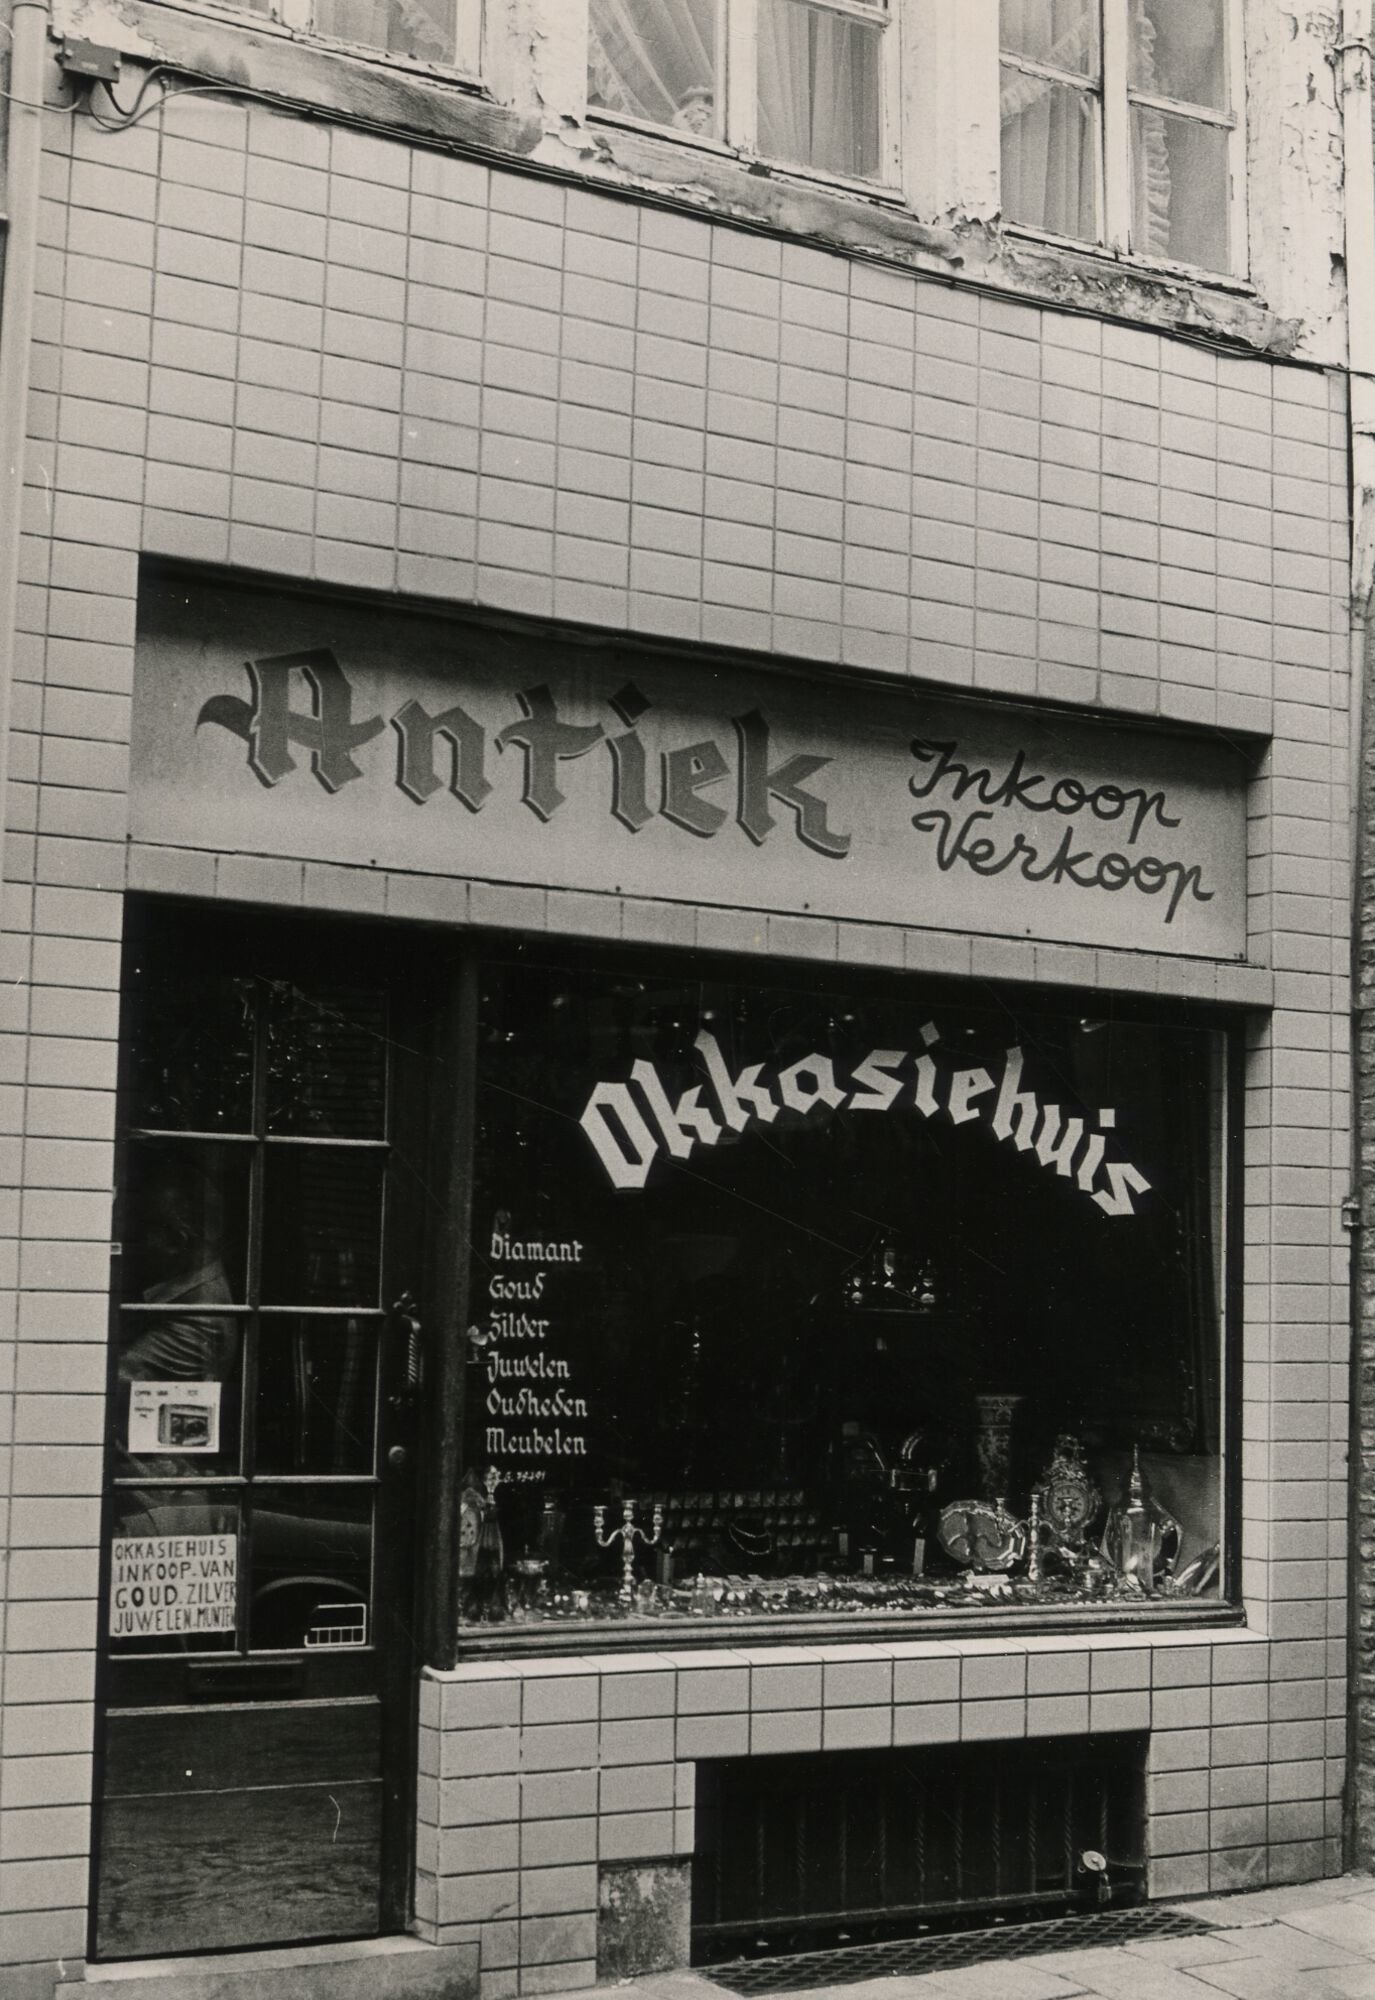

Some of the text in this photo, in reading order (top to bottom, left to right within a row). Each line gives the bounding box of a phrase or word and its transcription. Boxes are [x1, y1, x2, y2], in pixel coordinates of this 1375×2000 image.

[195, 647, 852, 860] Antiek
[908, 739, 1181, 844] Inkoop
[911, 810, 1215, 924] Verkoop
[579, 1022, 1152, 1217] Okkasiehuis
[490, 1233, 583, 1262] Diamant
[489, 1272, 547, 1299] Goud
[487, 1309, 550, 1342] Zilver
[487, 1351, 571, 1383] Juwelen
[486, 1388, 588, 1417] Oudheden
[486, 1427, 587, 1455] Meubelen
[115, 1539, 227, 1560] OKKASIEHUIS
